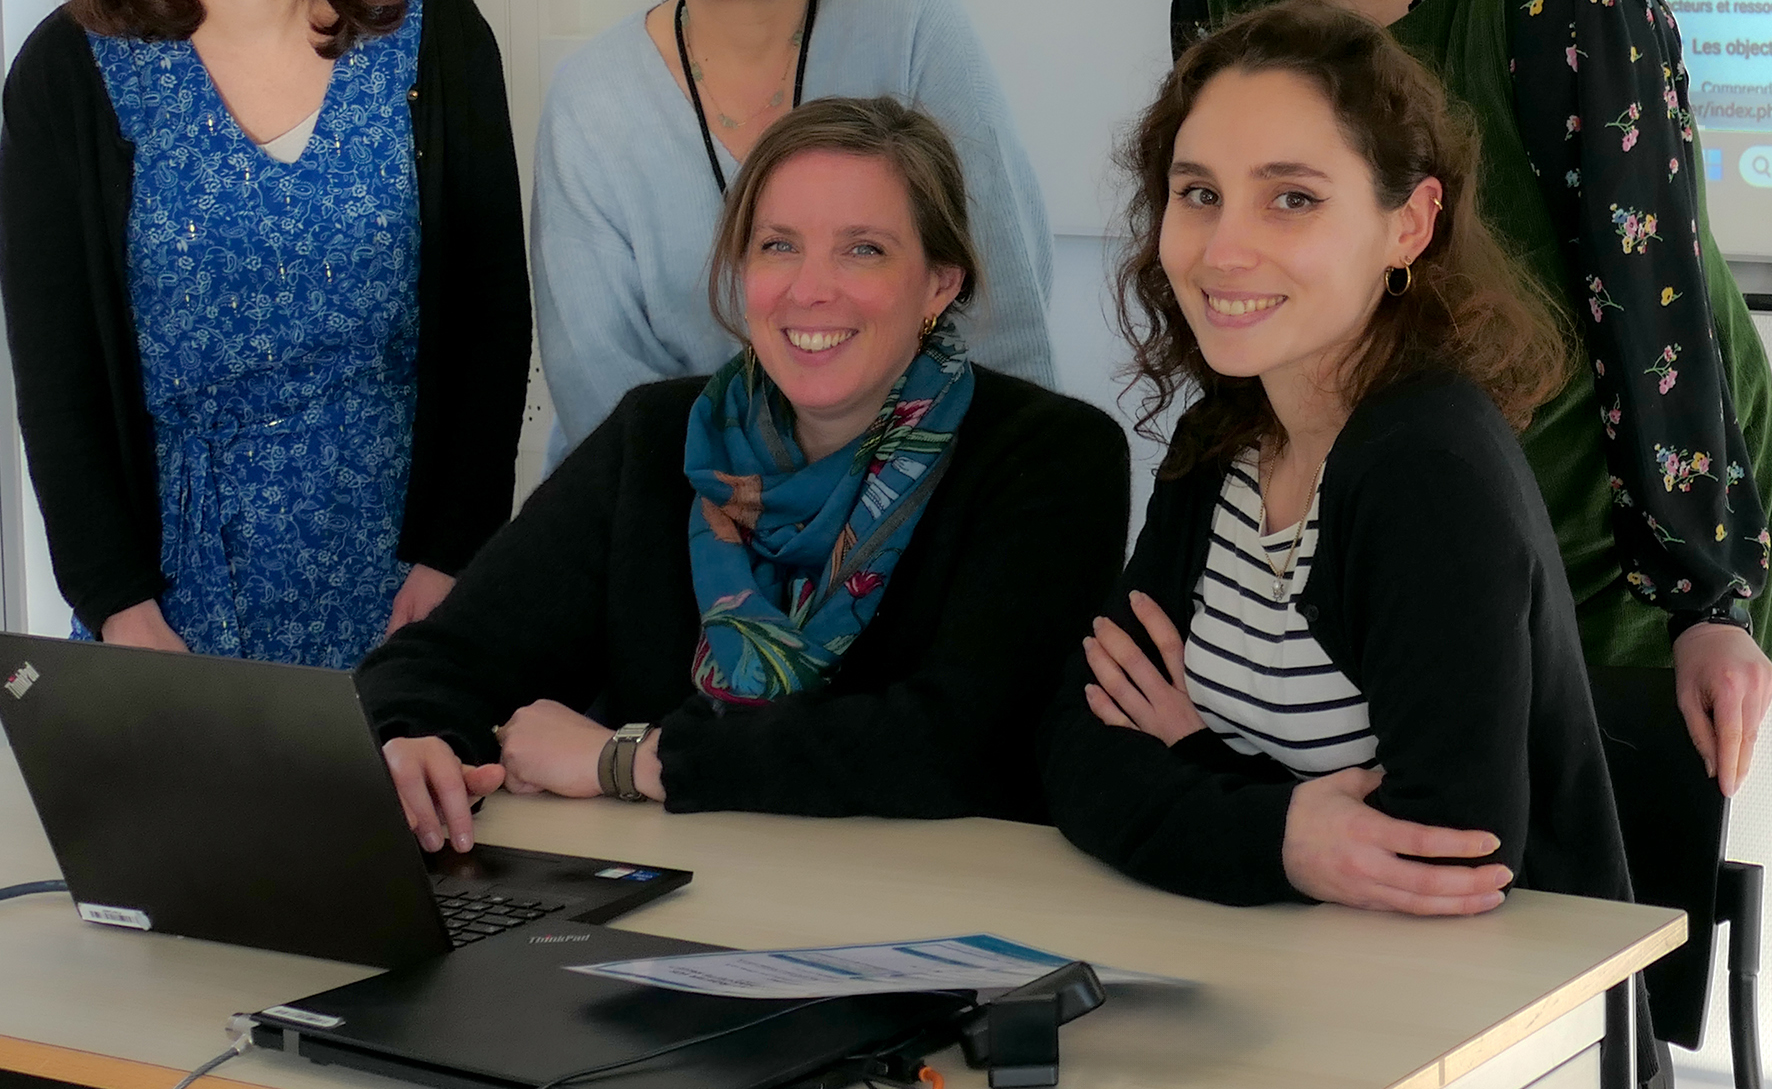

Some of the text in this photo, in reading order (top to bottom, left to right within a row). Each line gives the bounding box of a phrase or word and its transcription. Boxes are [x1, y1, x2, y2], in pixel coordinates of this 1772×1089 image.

[1716, 0, 1731, 14] et
[1692, 38, 1722, 57] Les
[528, 933, 591, 945] ThinkPad
